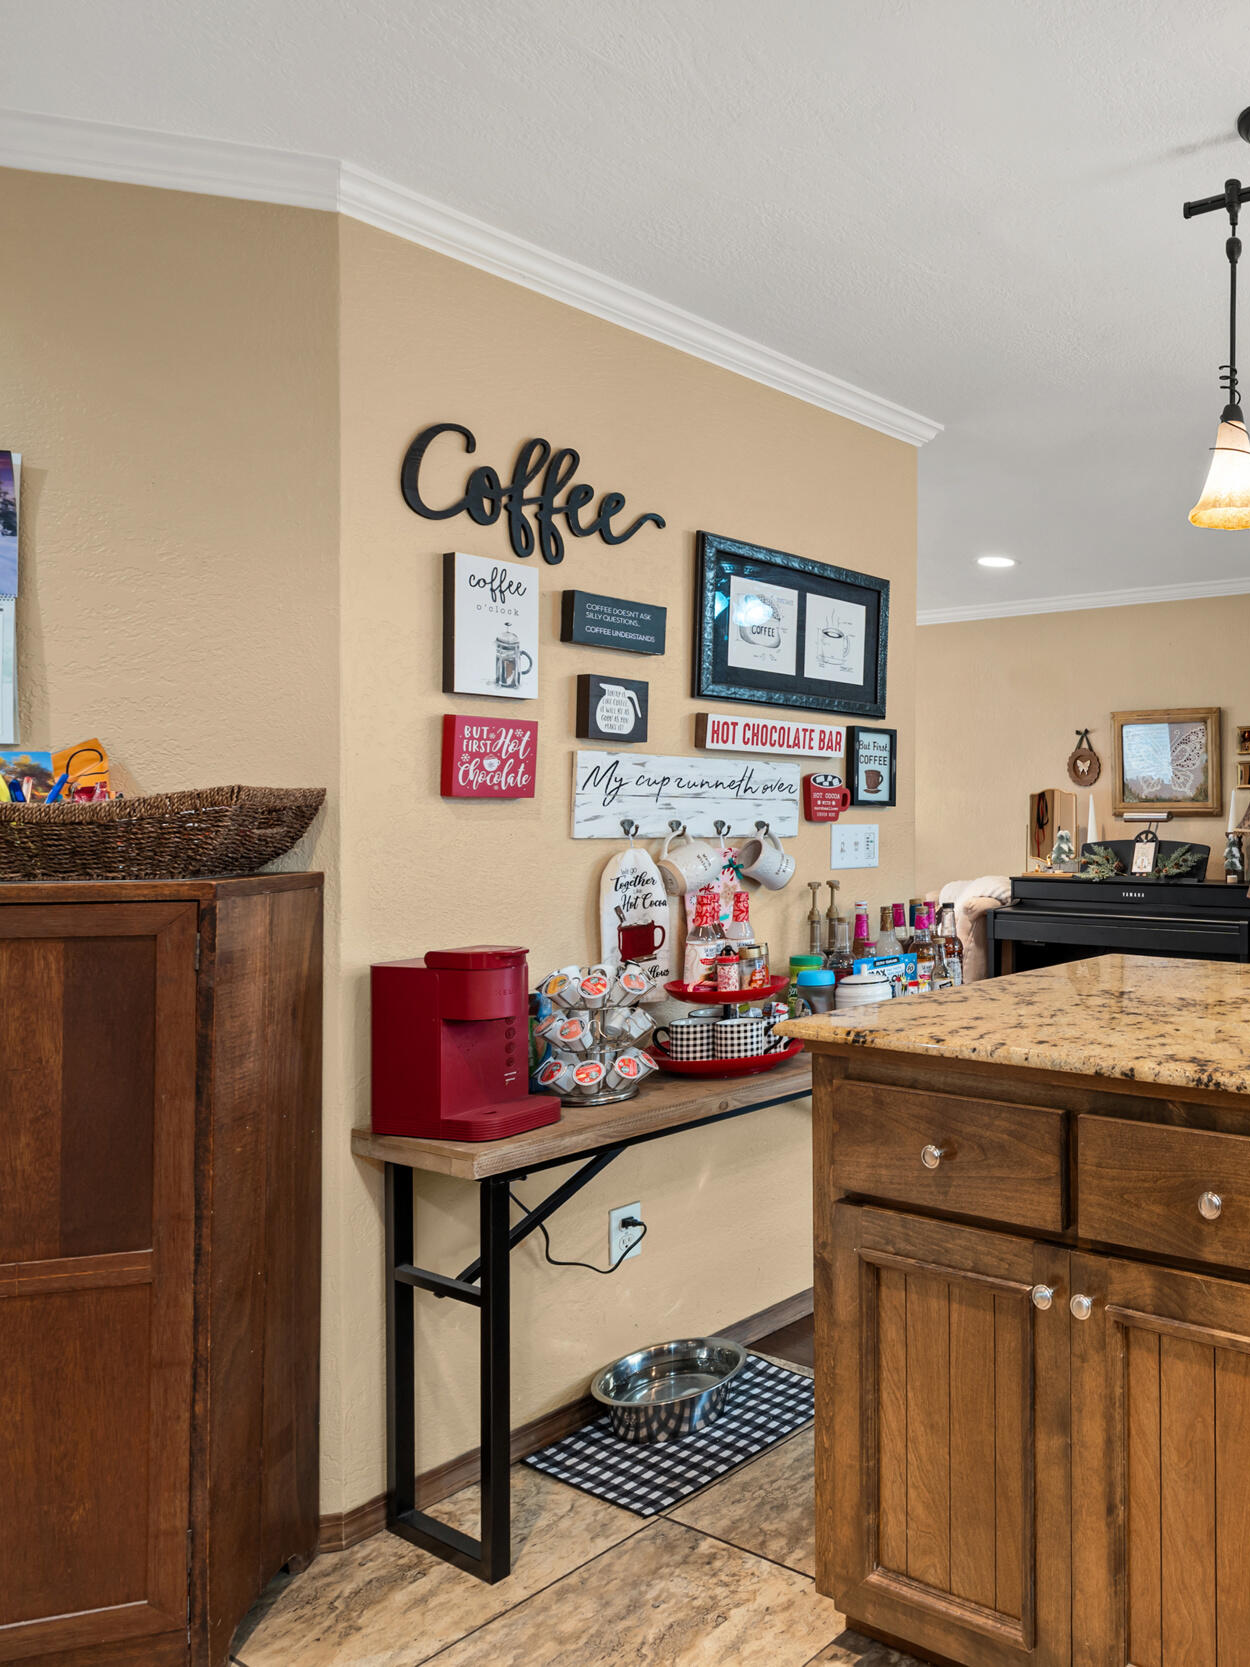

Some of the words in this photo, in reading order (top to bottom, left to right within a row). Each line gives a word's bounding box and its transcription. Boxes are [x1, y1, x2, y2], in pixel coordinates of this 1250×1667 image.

[400, 422, 666, 566] Coffee
[468, 566, 527, 604] coffee
[476, 603, 520, 617] o'clock
[585, 611, 602, 620] SILLY
[586, 603, 612, 614] COFFEE
[612, 608, 639, 619] DOESN'T
[639, 612, 653, 621] ASK
[585, 625, 612, 636] COFFEE
[751, 624, 776, 639] COFFEE
[464, 725, 489, 739] BUT
[711, 720, 739, 745] HOT
[742, 722, 815, 751] CHOCOLATE
[818, 729, 842, 753] BAR
[463, 739, 492, 753] FIRST
[492, 727, 531, 760] Hot
[859, 740, 871, 751] But
[859, 754, 888, 766] COFFEE
[457, 758, 531, 790] Chocolate
[581, 760, 629, 807] My
[635, 773, 671, 804] cup
[673, 765, 759, 798] runneth
[760, 776, 798, 795] over
[610, 871, 657, 893] Together
[621, 893, 639, 912] Hot
[642, 892, 667, 909] Cocoa
